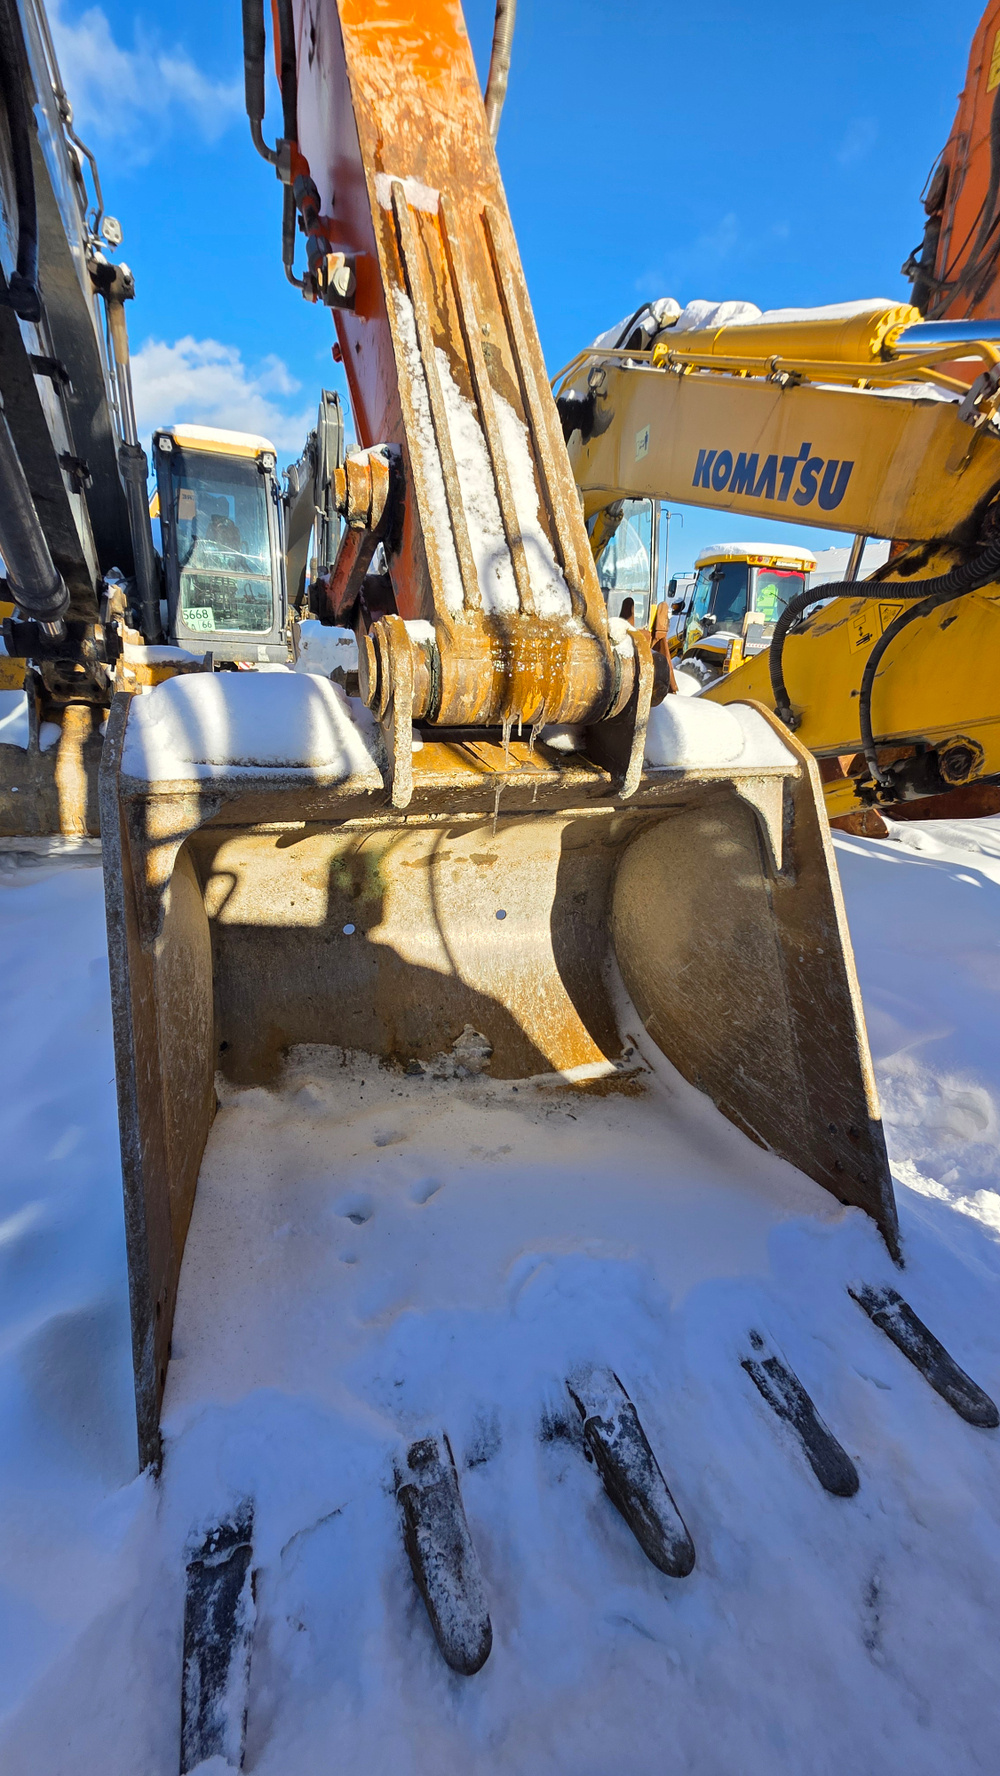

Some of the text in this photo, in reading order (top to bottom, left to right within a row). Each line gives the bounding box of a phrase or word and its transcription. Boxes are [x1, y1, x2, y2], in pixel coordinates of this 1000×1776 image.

[692, 442, 854, 511] KOMATSU
[183, 609, 208, 620] 5668
[202, 620, 212, 629] 66
